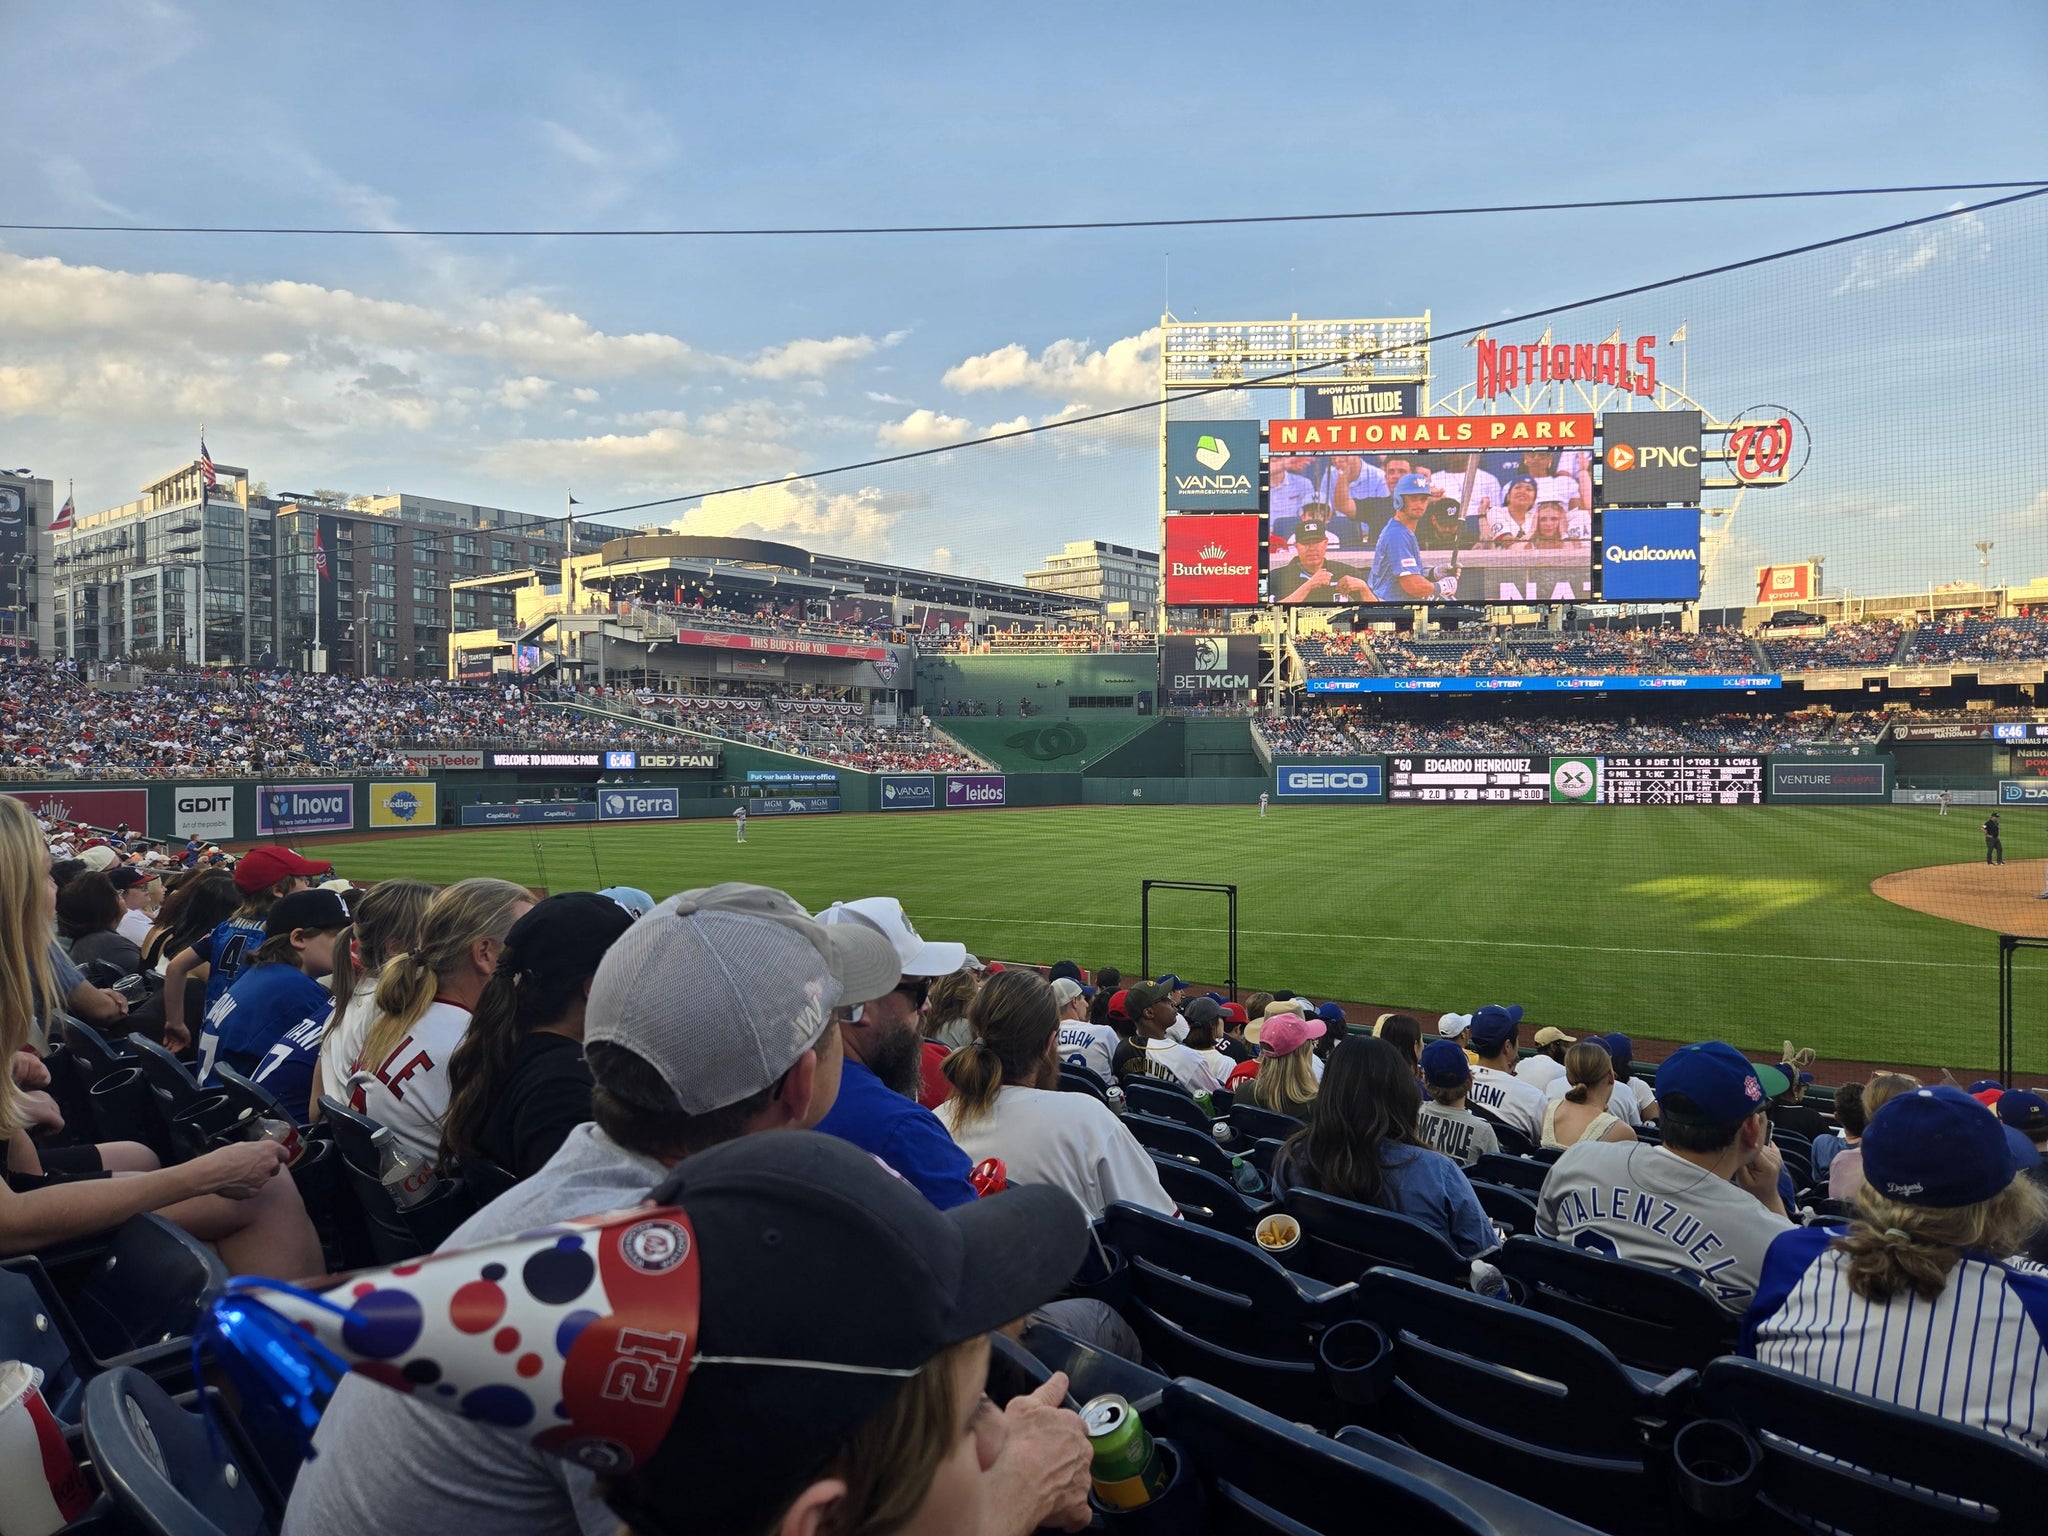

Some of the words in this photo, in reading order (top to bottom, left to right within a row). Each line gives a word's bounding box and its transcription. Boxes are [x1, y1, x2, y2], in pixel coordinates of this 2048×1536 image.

[1476, 335, 1656, 399] NATIONALS
[1317, 386, 1344, 395] SHOW
[1345, 384, 1370, 394] SOME
[1332, 390, 1402, 416] NATITUDE
[1281, 423, 1472, 444] NATIONALS
[1490, 420, 1577, 440] PARK
[1638, 446, 1698, 468] PNC
[1175, 475, 1252, 489] VANDA
[1605, 545, 1697, 563] Qualcomm
[1172, 562, 1253, 576] Budweiser
[1767, 592, 1800, 600] TOYOTA
[749, 637, 769, 649] THIS
[770, 639, 794, 651] BUD'S
[795, 641, 811, 652] FOR
[812, 642, 830, 655] YOU.
[468, 653, 478, 661] TEAM
[478, 652, 491, 660] STORE
[1174, 674, 1249, 689] BETMGM
[1910, 725, 1961, 735] WASHINGTON
[1933, 730, 1977, 739] NATIONALS
[1997, 726, 2023, 737] 6:46
[407, 754, 439, 766] arris
[440, 754, 481, 766] Teeter
[493, 754, 530, 766] WELCOME
[531, 754, 540, 766] TO
[540, 754, 579, 766] NATIONALS
[580, 754, 600, 766] PARK
[610, 754, 631, 767] 6:46
[679, 755, 714, 767] FAN
[1394, 758, 1412, 772] #60
[1424, 758, 1473, 773] EDGARDO
[1474, 758, 1531, 773] HENRIQUEZ
[1615, 758, 1630, 766] STL
[1635, 758, 1641, 766] 6
[1653, 758, 1670, 766] DET
[1672, 758, 1680, 766] 11
[1694, 758, 1711, 766] TOR
[1713, 758, 1720, 766] 3
[1732, 758, 1751, 766] CWS
[1752, 758, 1758, 766] 6
[800, 774, 816, 782] your
[1615, 770, 1630, 778] MIL
[1635, 770, 1641, 778] 5
[1653, 770, 1665, 778] KC
[1672, 770, 1679, 778] 2
[1779, 775, 1831, 785] VENTURE
[1288, 772, 1369, 789] GEICO
[740, 786, 749, 797] 377
[895, 786, 931, 796] VANDA
[966, 784, 1003, 801] leidos
[1132, 788, 1142, 798] 402
[1428, 790, 1440, 799] 2.0
[1463, 790, 1469, 799] 2
[1494, 790, 1504, 799] 1-0
[1524, 790, 1540, 799] 9.00
[177, 797, 232, 813] GDIT
[292, 794, 343, 815] Inova
[383, 799, 424, 810] Pedigree
[626, 796, 673, 812] Terra
[764, 800, 783, 808] MGM
[811, 799, 828, 807] MGM
[486, 812, 510, 820] Capital
[218, 935, 247, 980] 4
[1420, 1113, 1440, 1146] WE
[1438, 1118, 1475, 1159] RULE
[1887, 1181, 1924, 1197] Dodgers
[1560, 1186, 1753, 1300] VALENZUELA
[602, 1327, 686, 1408] 21
